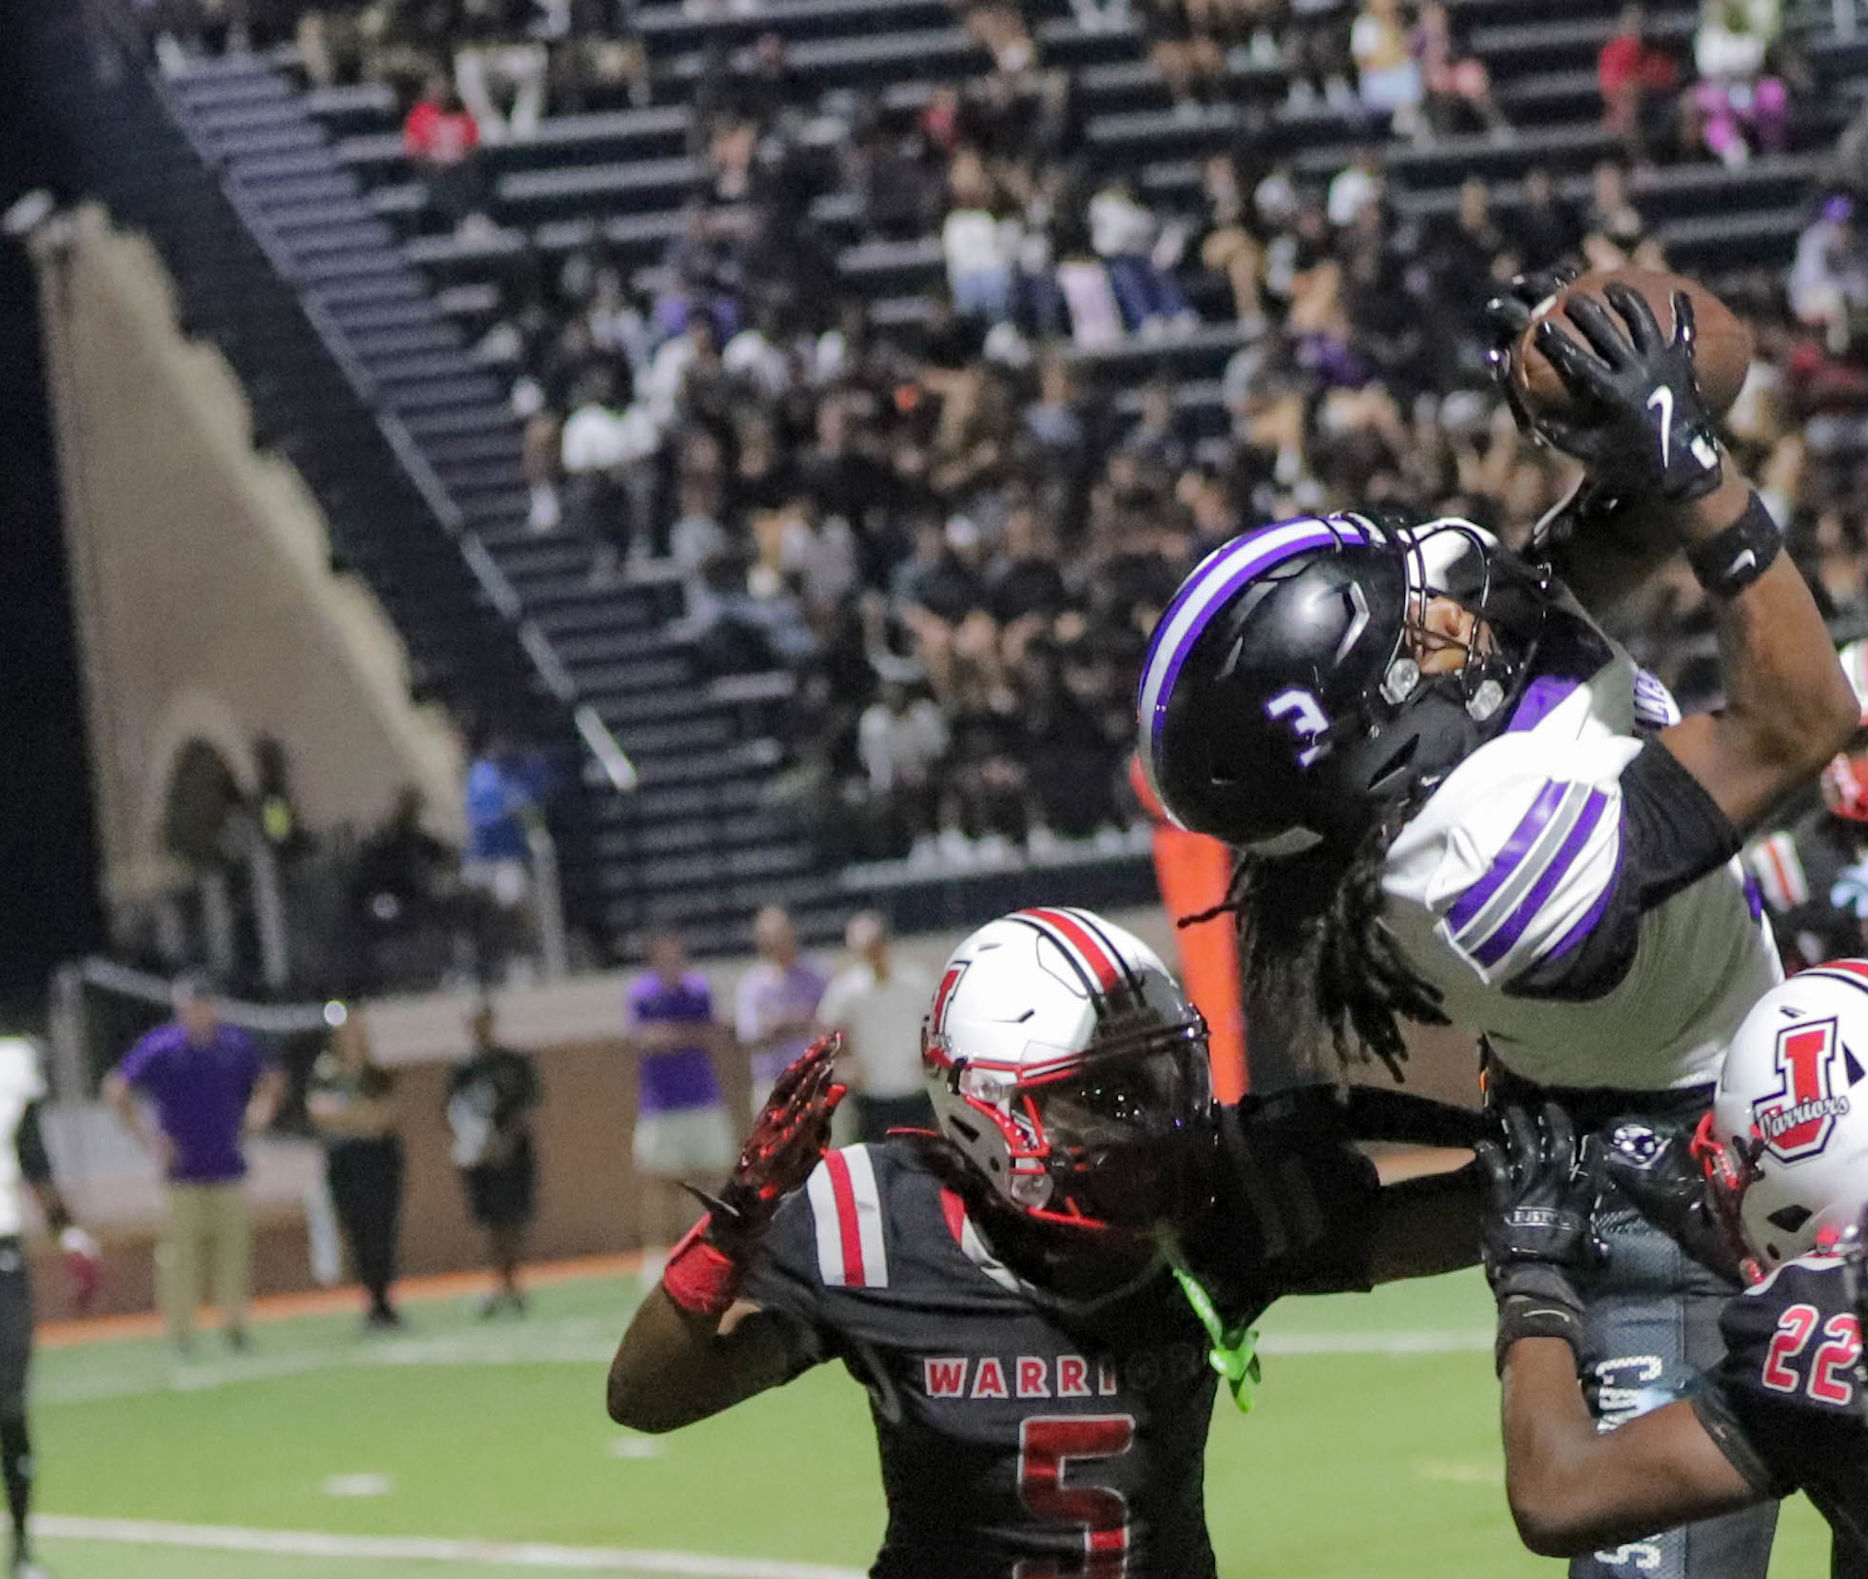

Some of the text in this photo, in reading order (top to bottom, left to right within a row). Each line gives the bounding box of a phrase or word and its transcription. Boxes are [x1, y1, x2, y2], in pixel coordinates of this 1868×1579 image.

[1264, 687, 1331, 768] 3
[1752, 1014, 1838, 1163] J
[923, 1354, 1119, 1400] WARRI
[1762, 1303, 1864, 1407] 22
